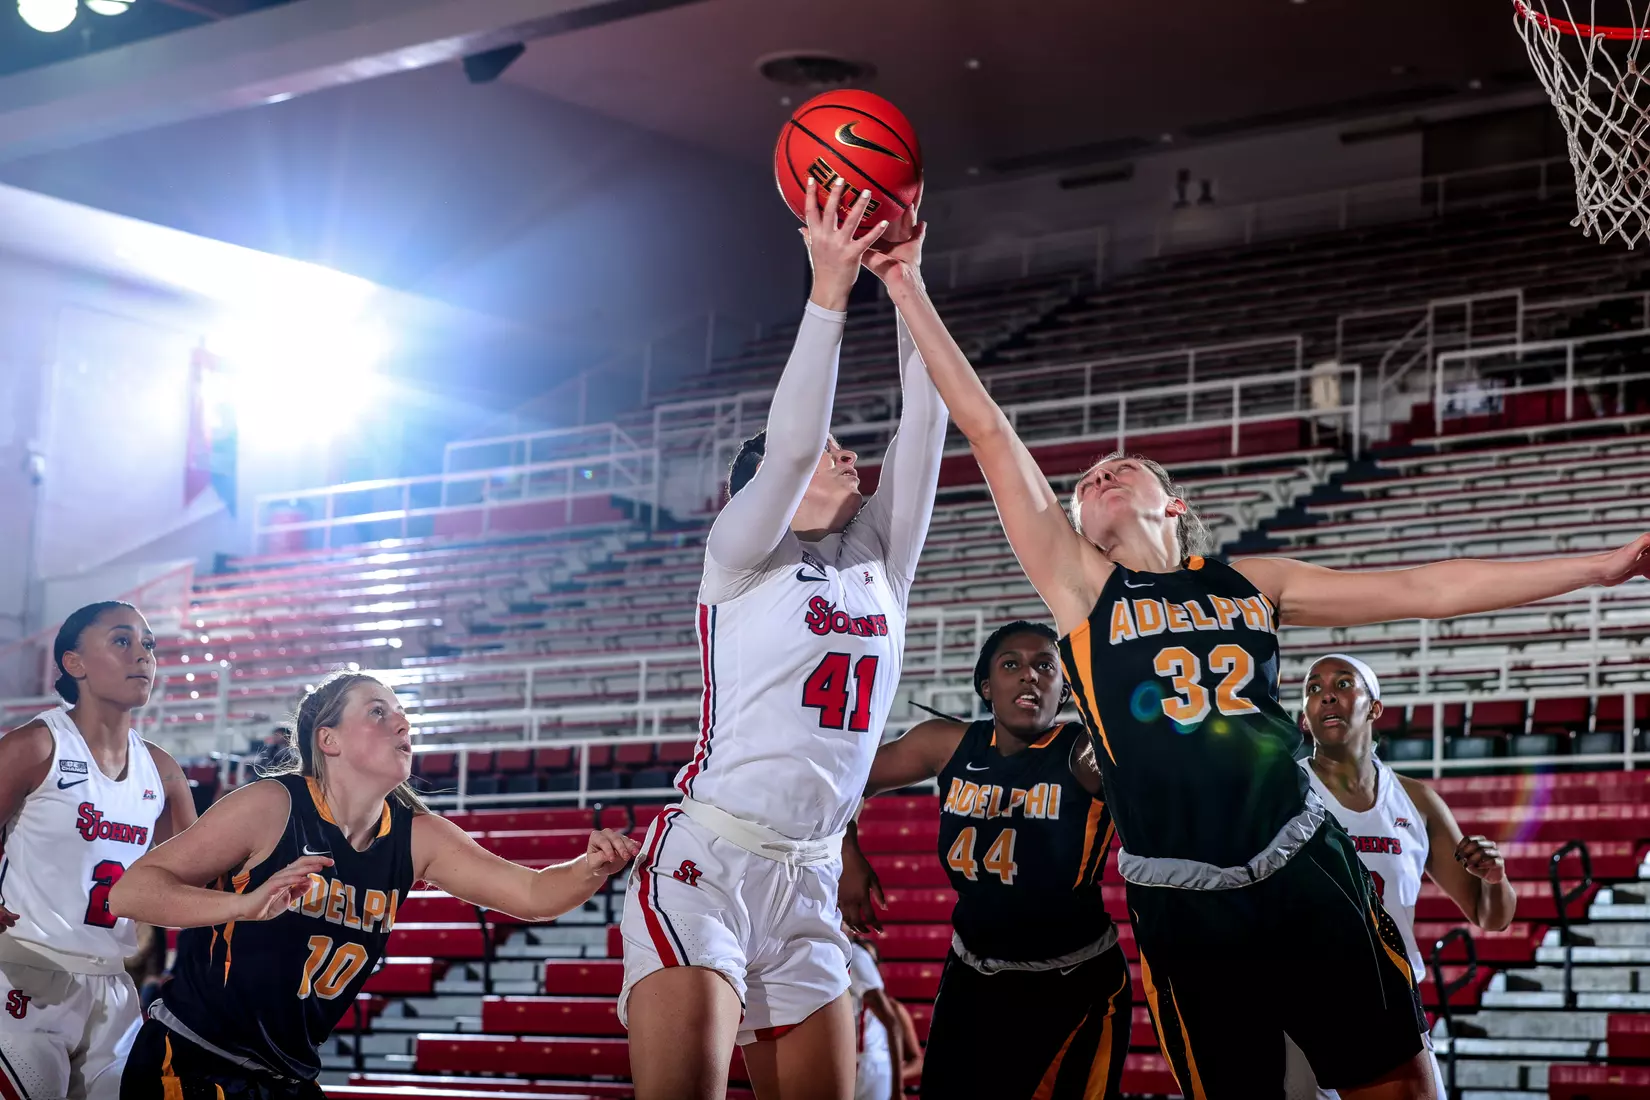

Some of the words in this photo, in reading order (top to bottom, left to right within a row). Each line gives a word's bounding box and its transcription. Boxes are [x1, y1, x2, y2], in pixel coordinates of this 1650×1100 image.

[1109, 593, 1277, 645] ADELPHI
[801, 651, 879, 733] 41
[1153, 643, 1261, 726] 32
[943, 776, 1062, 820] ADELPHI
[946, 826, 1018, 885] 44
[84, 859, 126, 929] 2
[297, 935, 369, 1000] 10
